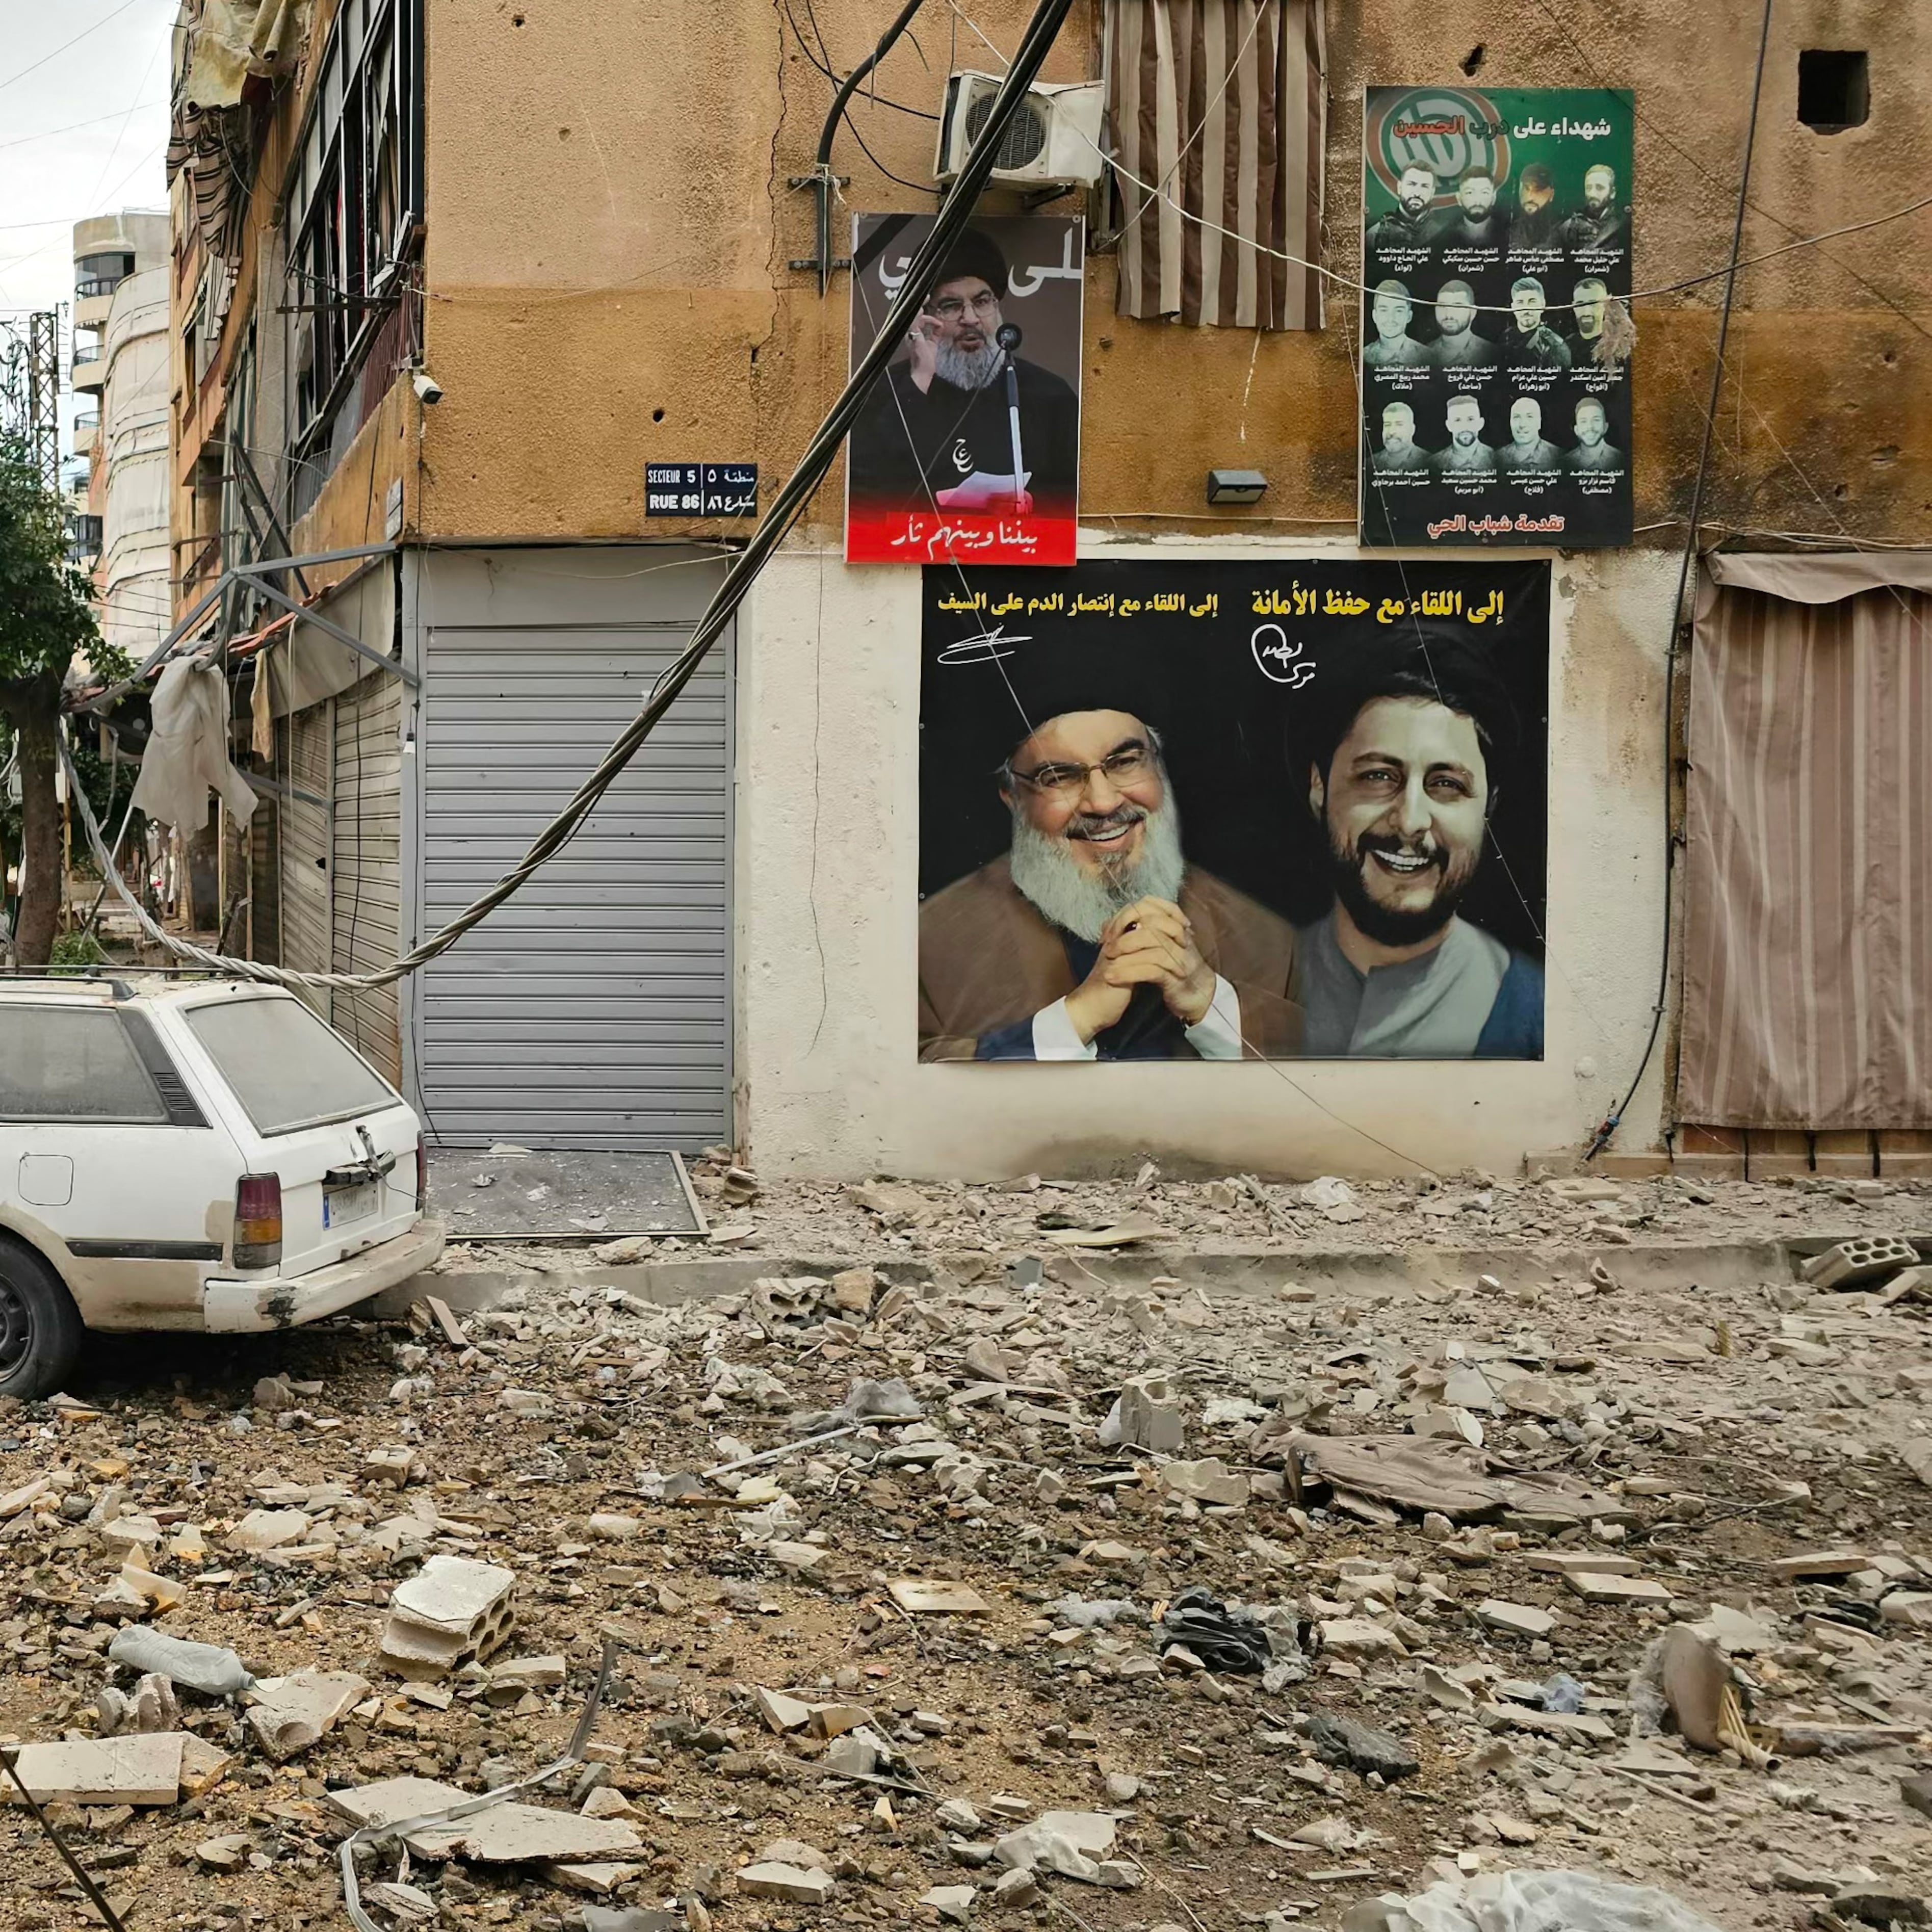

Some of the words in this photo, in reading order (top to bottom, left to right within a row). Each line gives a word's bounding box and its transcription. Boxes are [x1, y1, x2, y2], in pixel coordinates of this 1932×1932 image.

[1393, 115, 1465, 139] الحسين
[1470, 118, 1509, 141] درب
[1513, 117, 1546, 139] على
[1551, 116, 1611, 140] شهداء
[1406, 247, 1431, 255] الشهيد
[1474, 247, 1498, 255] الشهيد
[1537, 248, 1562, 256] الشهيد
[1599, 248, 1624, 256] الشهيد
[1473, 365, 1498, 374] الشهيد
[1537, 365, 1561, 374] الشهيد
[648, 469, 680, 483] SECTEUR
[687, 470, 696, 483] 5
[708, 469, 717, 482] ٥
[724, 469, 754, 483] منطقة
[1472, 469, 1497, 477] الشهيد
[1536, 469, 1561, 477] الشهيد
[1600, 469, 1625, 478] الشهيد
[649, 494, 678, 509] RUE
[682, 494, 699, 509] 86
[707, 495, 722, 509] ٨٦
[891, 514, 923, 545] ثأر
[1427, 515, 1467, 539] الحي
[1469, 515, 1512, 536] شباب
[1515, 513, 1565, 532] تقدمة
[999, 521, 1037, 554] بيننا
[938, 592, 986, 614] السيف
[991, 592, 1023, 615] على
[1028, 592, 1064, 616] الدم
[1067, 593, 1114, 617] إنتصار
[1119, 598, 1141, 616] مع
[1144, 593, 1185, 611] اللقاء
[1189, 593, 1218, 617] إلى
[1251, 580, 1316, 615] الأمانة
[1322, 588, 1370, 615] حفظ
[1410, 590, 1461, 615] اللقاء
[1467, 590, 1504, 624] إلى
[1376, 597, 1404, 623] مع
